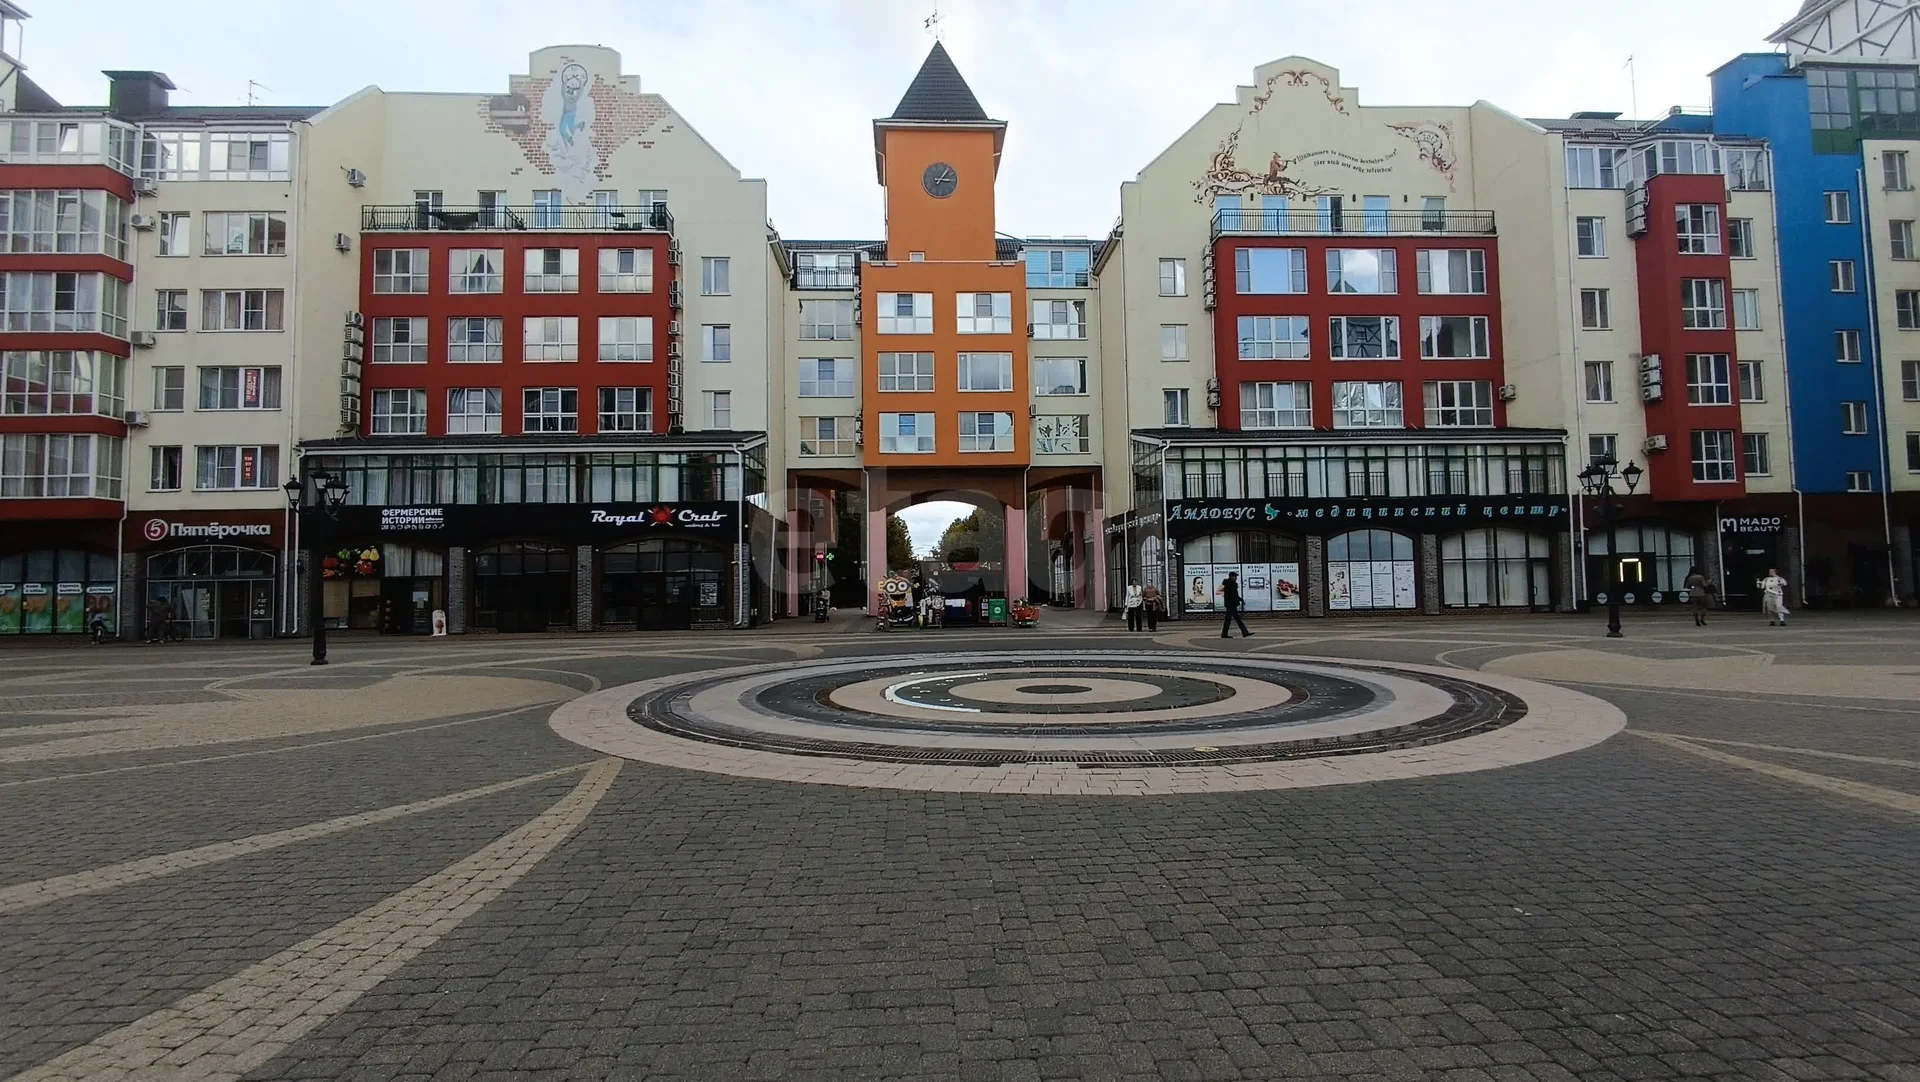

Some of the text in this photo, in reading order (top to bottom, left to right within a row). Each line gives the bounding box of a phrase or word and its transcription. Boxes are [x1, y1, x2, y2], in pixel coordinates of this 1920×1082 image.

[381, 508, 444, 516] ФЕРМЕРСКИЕ
[590, 509, 728, 526] Royal Crab
[1482, 504, 1564, 519] центр
[381, 516, 425, 525] ИСТОРИИ
[1739, 517, 1781, 525] MADO
[170, 522, 271, 539] Пятёрочка
